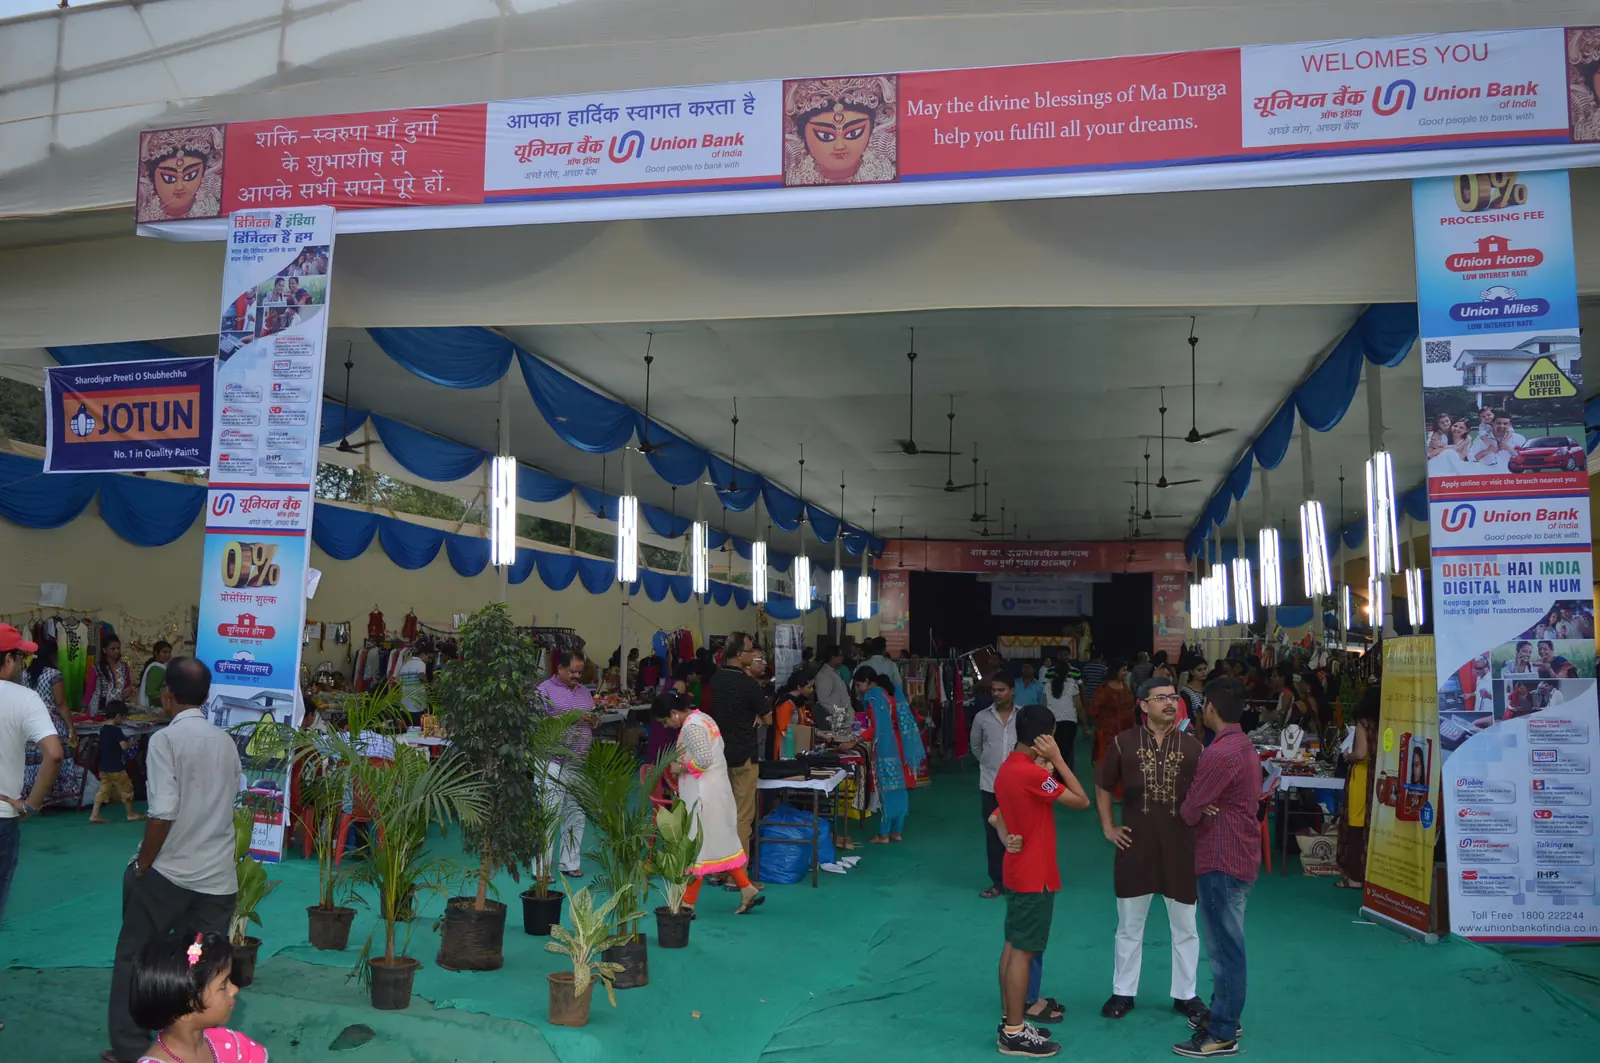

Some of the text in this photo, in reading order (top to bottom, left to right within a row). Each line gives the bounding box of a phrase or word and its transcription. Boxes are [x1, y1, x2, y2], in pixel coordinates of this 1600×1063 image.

[1301, 43, 1488, 72] WELOMES YOU
[1423, 81, 1540, 102] Union Bank
[907, 80, 1227, 119] May the divine blessings of Ma Durga
[1254, 85, 1366, 118] यूनियन बैंक
[1500, 98, 1536, 109] of India
[506, 92, 756, 130] आपका हार्दिक स्वागत करता है
[1418, 112, 1534, 126] Good people to bank with
[376, 116, 399, 139] माँ
[404, 114, 440, 144] दुर्गा
[933, 115, 1198, 148] help you fulfill all your dreams.
[514, 135, 604, 163] यूनियन बैंक
[650, 132, 744, 152] Union Bank
[711, 148, 742, 158] of India
[282, 145, 408, 177] के शुभाशीष से
[645, 160, 740, 174] Good people to bank with
[237, 170, 451, 203] आपके सभी सपने पूरे हों.
[234, 215, 271, 228] डिजिटल
[274, 214, 282, 228] है
[1440, 210, 1544, 226] PROCESSING FEE
[233, 230, 278, 244] डिजिटल
[294, 232, 314, 243] हम
[1453, 254, 1536, 268] Union Home
[1462, 270, 1528, 280] LOW INTEREST RATE
[1460, 303, 1539, 318] Union Miles
[1468, 322, 1482, 330] LOW
[1484, 321, 1515, 330] INTEREST
[75, 375, 112, 385] Sharodiyar
[113, 374, 134, 382] Preeti
[143, 370, 187, 380] Shubhechha
[1528, 380, 1561, 388] PERIOD
[1529, 373, 1559, 381] LIMITED
[1529, 388, 1562, 396] OFFER
[98, 400, 192, 435] JOTUN
[114, 448, 198, 459] No. 1 in Quality Paints
[1441, 480, 1459, 488] Apply
[240, 494, 302, 513] यूनियन बैंक
[1484, 508, 1579, 522] Union Bank
[1548, 522, 1556, 530] of
[1506, 533, 1532, 542] people
[1544, 532, 1562, 540] bank
[222, 541, 280, 588] 0%
[1442, 560, 1581, 578] DIGITAL HAI INDIA
[1443, 579, 1581, 595] DIGITAL HAIN HUM
[220, 592, 278, 606] प्रोसेसिंग शुल्क
[1468, 608, 1490, 616] Digital
[226, 626, 266, 636] यूनियन होम
[218, 661, 241, 672] यूनियन
[1536, 842, 1562, 850] Talking
[1472, 911, 1488, 920] Toll
[1491, 911, 1514, 920] Free
[1548, 911, 1584, 920] 222244
[1458, 924, 1598, 932] www.unionbankofindia.co.in
